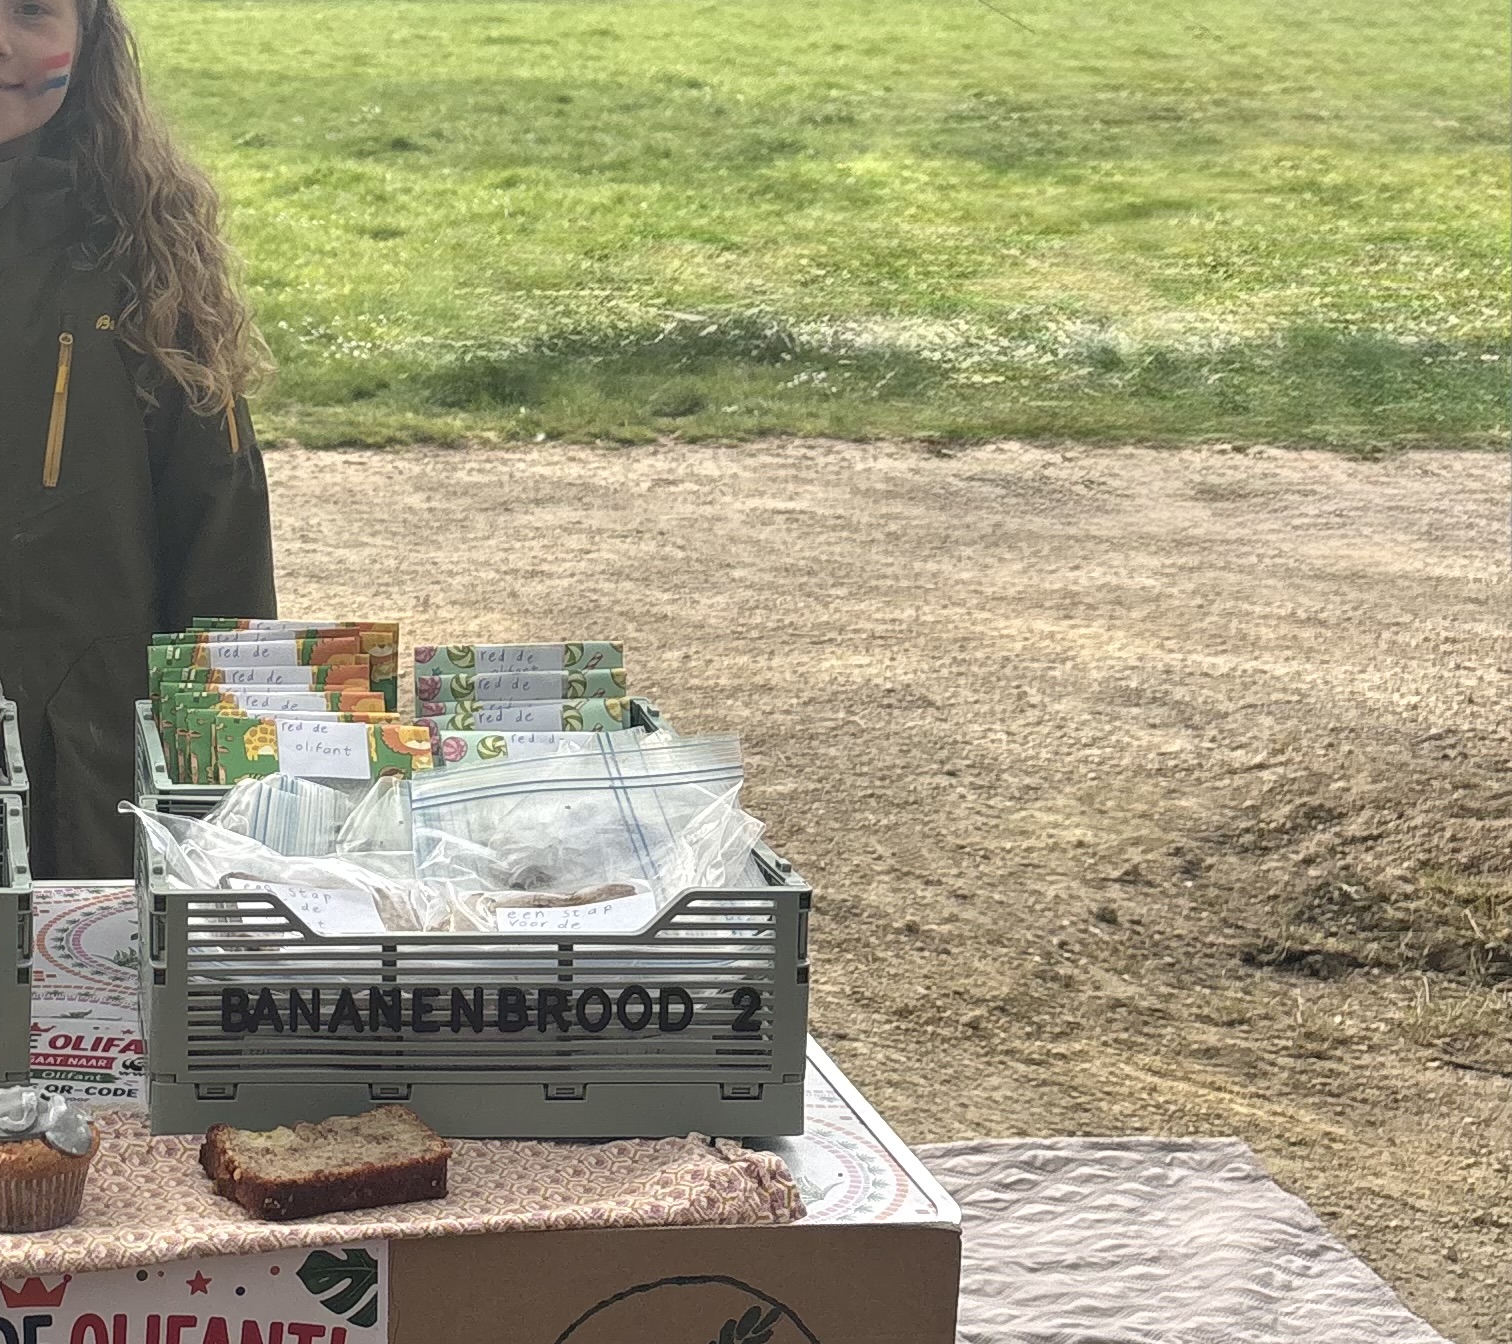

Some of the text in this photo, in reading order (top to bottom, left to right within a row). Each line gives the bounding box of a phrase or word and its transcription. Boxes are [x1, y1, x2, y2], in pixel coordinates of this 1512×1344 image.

[218, 645, 270, 658] red de
[480, 649, 534, 664] red de
[232, 669, 282, 684] red de
[478, 675, 530, 691] red de
[245, 696, 298, 711] red de
[478, 709, 534, 723] red de
[281, 722, 328, 733] red de
[511, 732, 535, 743] red
[295, 741, 352, 757] olifant
[507, 904, 613, 919] een stap
[508, 918, 582, 929] voor de
[221, 986, 763, 1033] BANANENBROOD 2
[48, 1034, 147, 1054] OLIFA
[67, 1057, 107, 1067] NAAR
[41, 1071, 101, 1081] Olifant
[44, 1084, 139, 1098] QR-CODE
